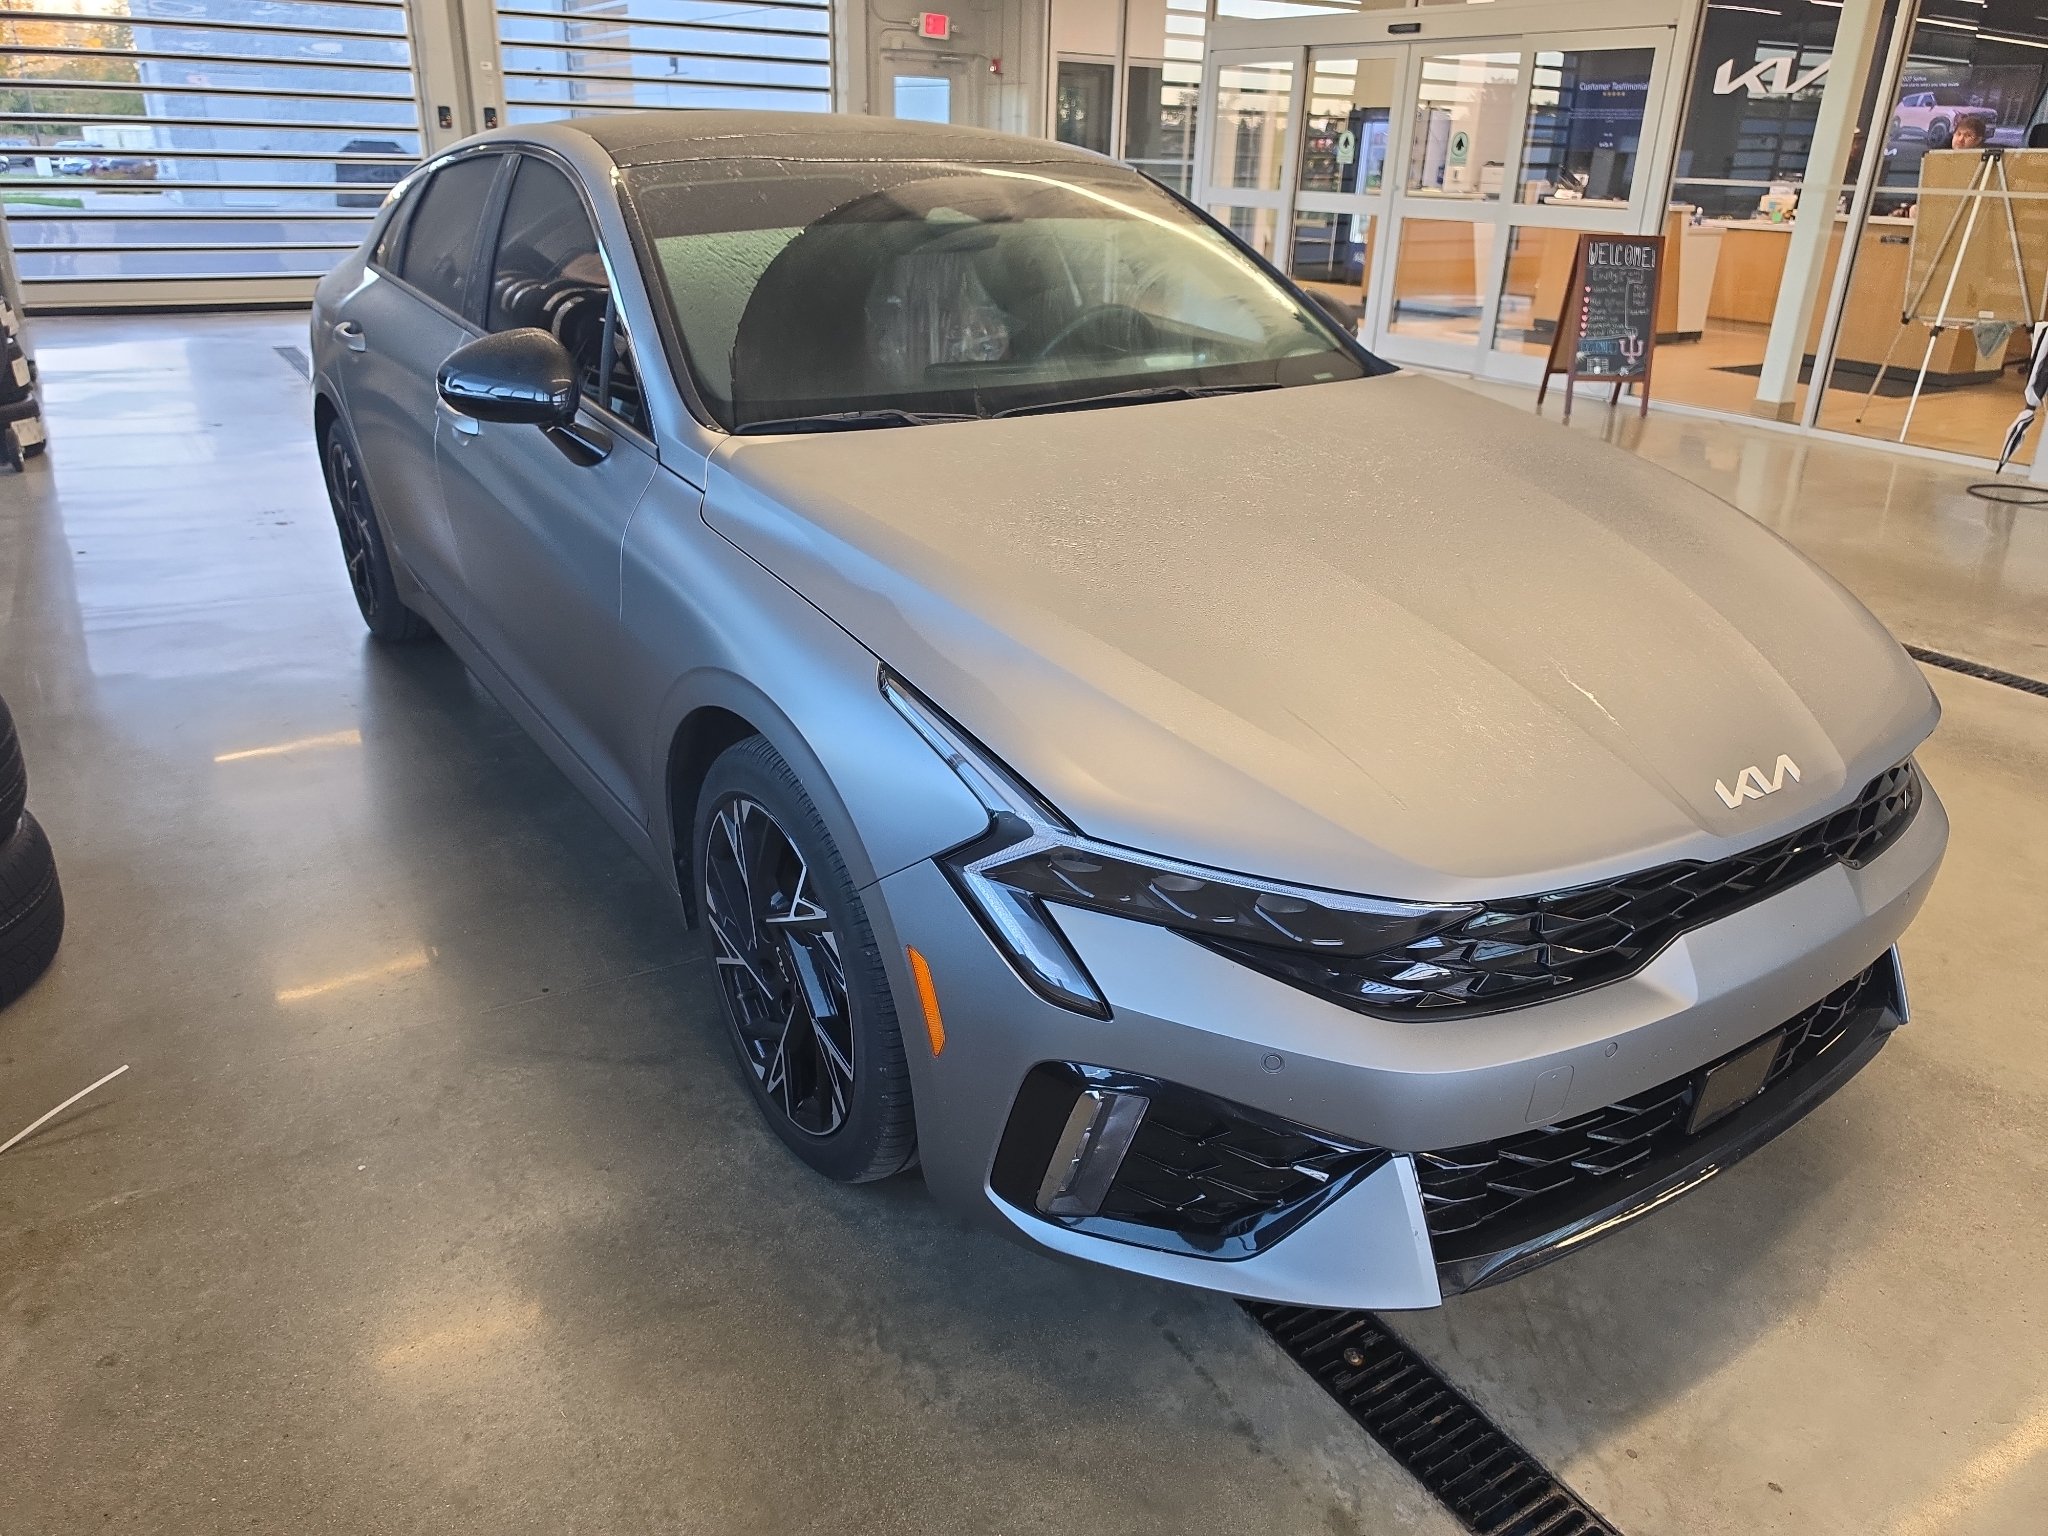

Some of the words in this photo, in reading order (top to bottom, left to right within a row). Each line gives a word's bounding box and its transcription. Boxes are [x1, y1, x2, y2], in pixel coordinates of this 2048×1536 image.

[1579, 82, 1611, 91] Customer
[1588, 241, 1656, 268] WELCOME!
[1714, 753, 1801, 810] KIA
